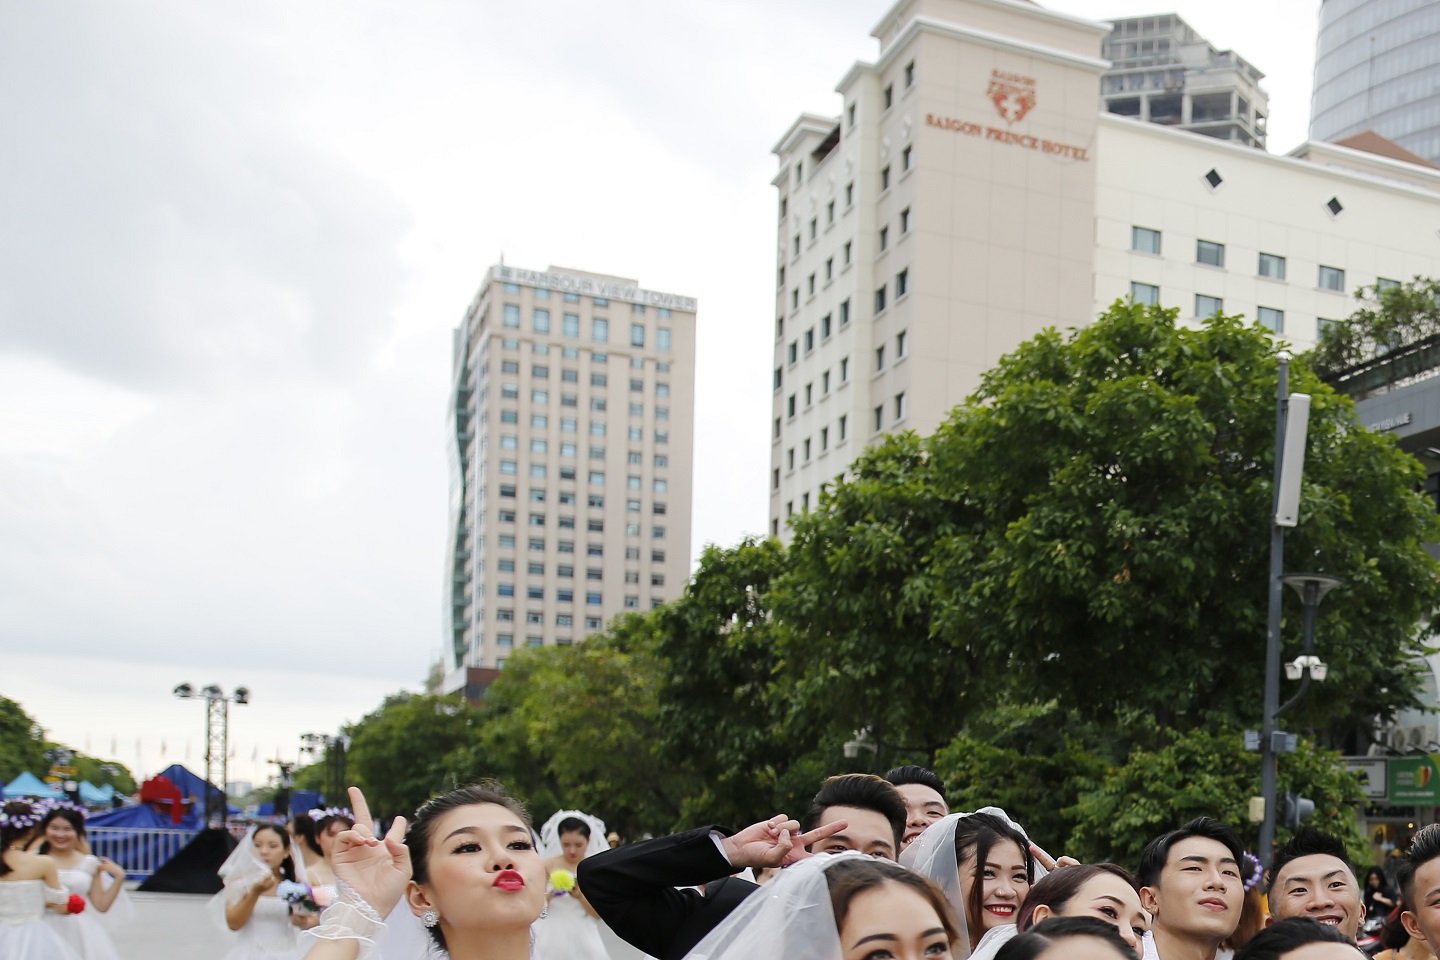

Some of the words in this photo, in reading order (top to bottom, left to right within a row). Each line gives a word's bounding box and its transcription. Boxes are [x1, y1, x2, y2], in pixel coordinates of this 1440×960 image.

[926, 114, 982, 136] SAIGON
[986, 127, 1038, 149] PRINCE
[1041, 140, 1089, 161] HOTEL
[597, 280, 636, 299] VIEW
